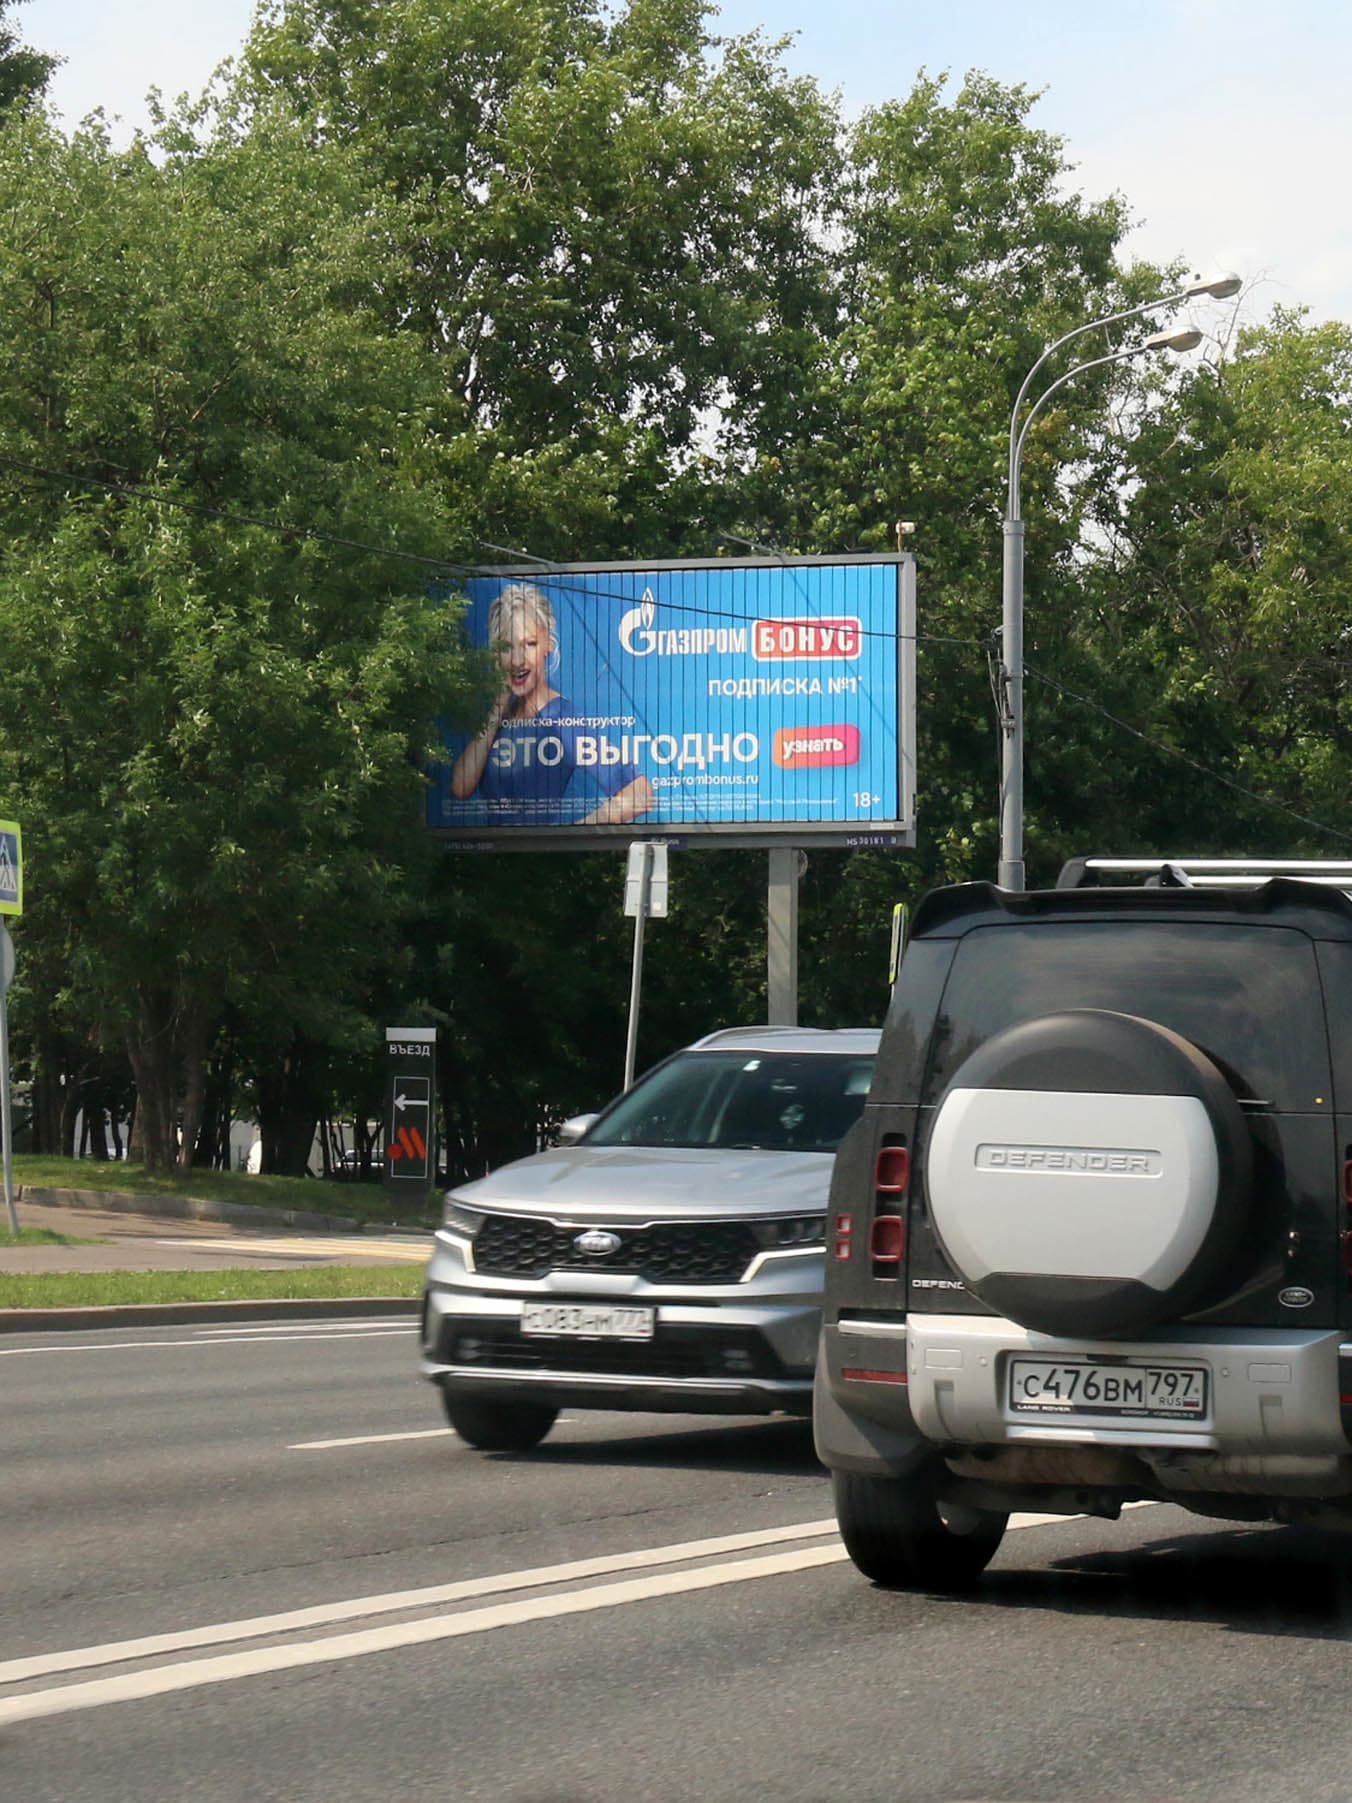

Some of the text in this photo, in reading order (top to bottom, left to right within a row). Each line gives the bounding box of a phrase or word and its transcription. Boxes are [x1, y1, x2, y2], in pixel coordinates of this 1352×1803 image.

[657, 625, 854, 656] ГАЗПРОМ БОНУС
[708, 678, 823, 699] ПОДПИСКА
[501, 715, 636, 731] одписка-конструктор
[492, 731, 760, 771] ЭТО ВЫГОДНО
[782, 738, 845, 760] узнать
[651, 772, 760, 789] gazprombonus.ru
[852, 792, 881, 808] 18+
[389, 1044, 431, 1057] ВЪЕЗД
[989, 1149, 1150, 1172] DEFENDER
[1023, 1368, 1195, 1403] С476ВМ 797
[1159, 1396, 1182, 1406] RUS
